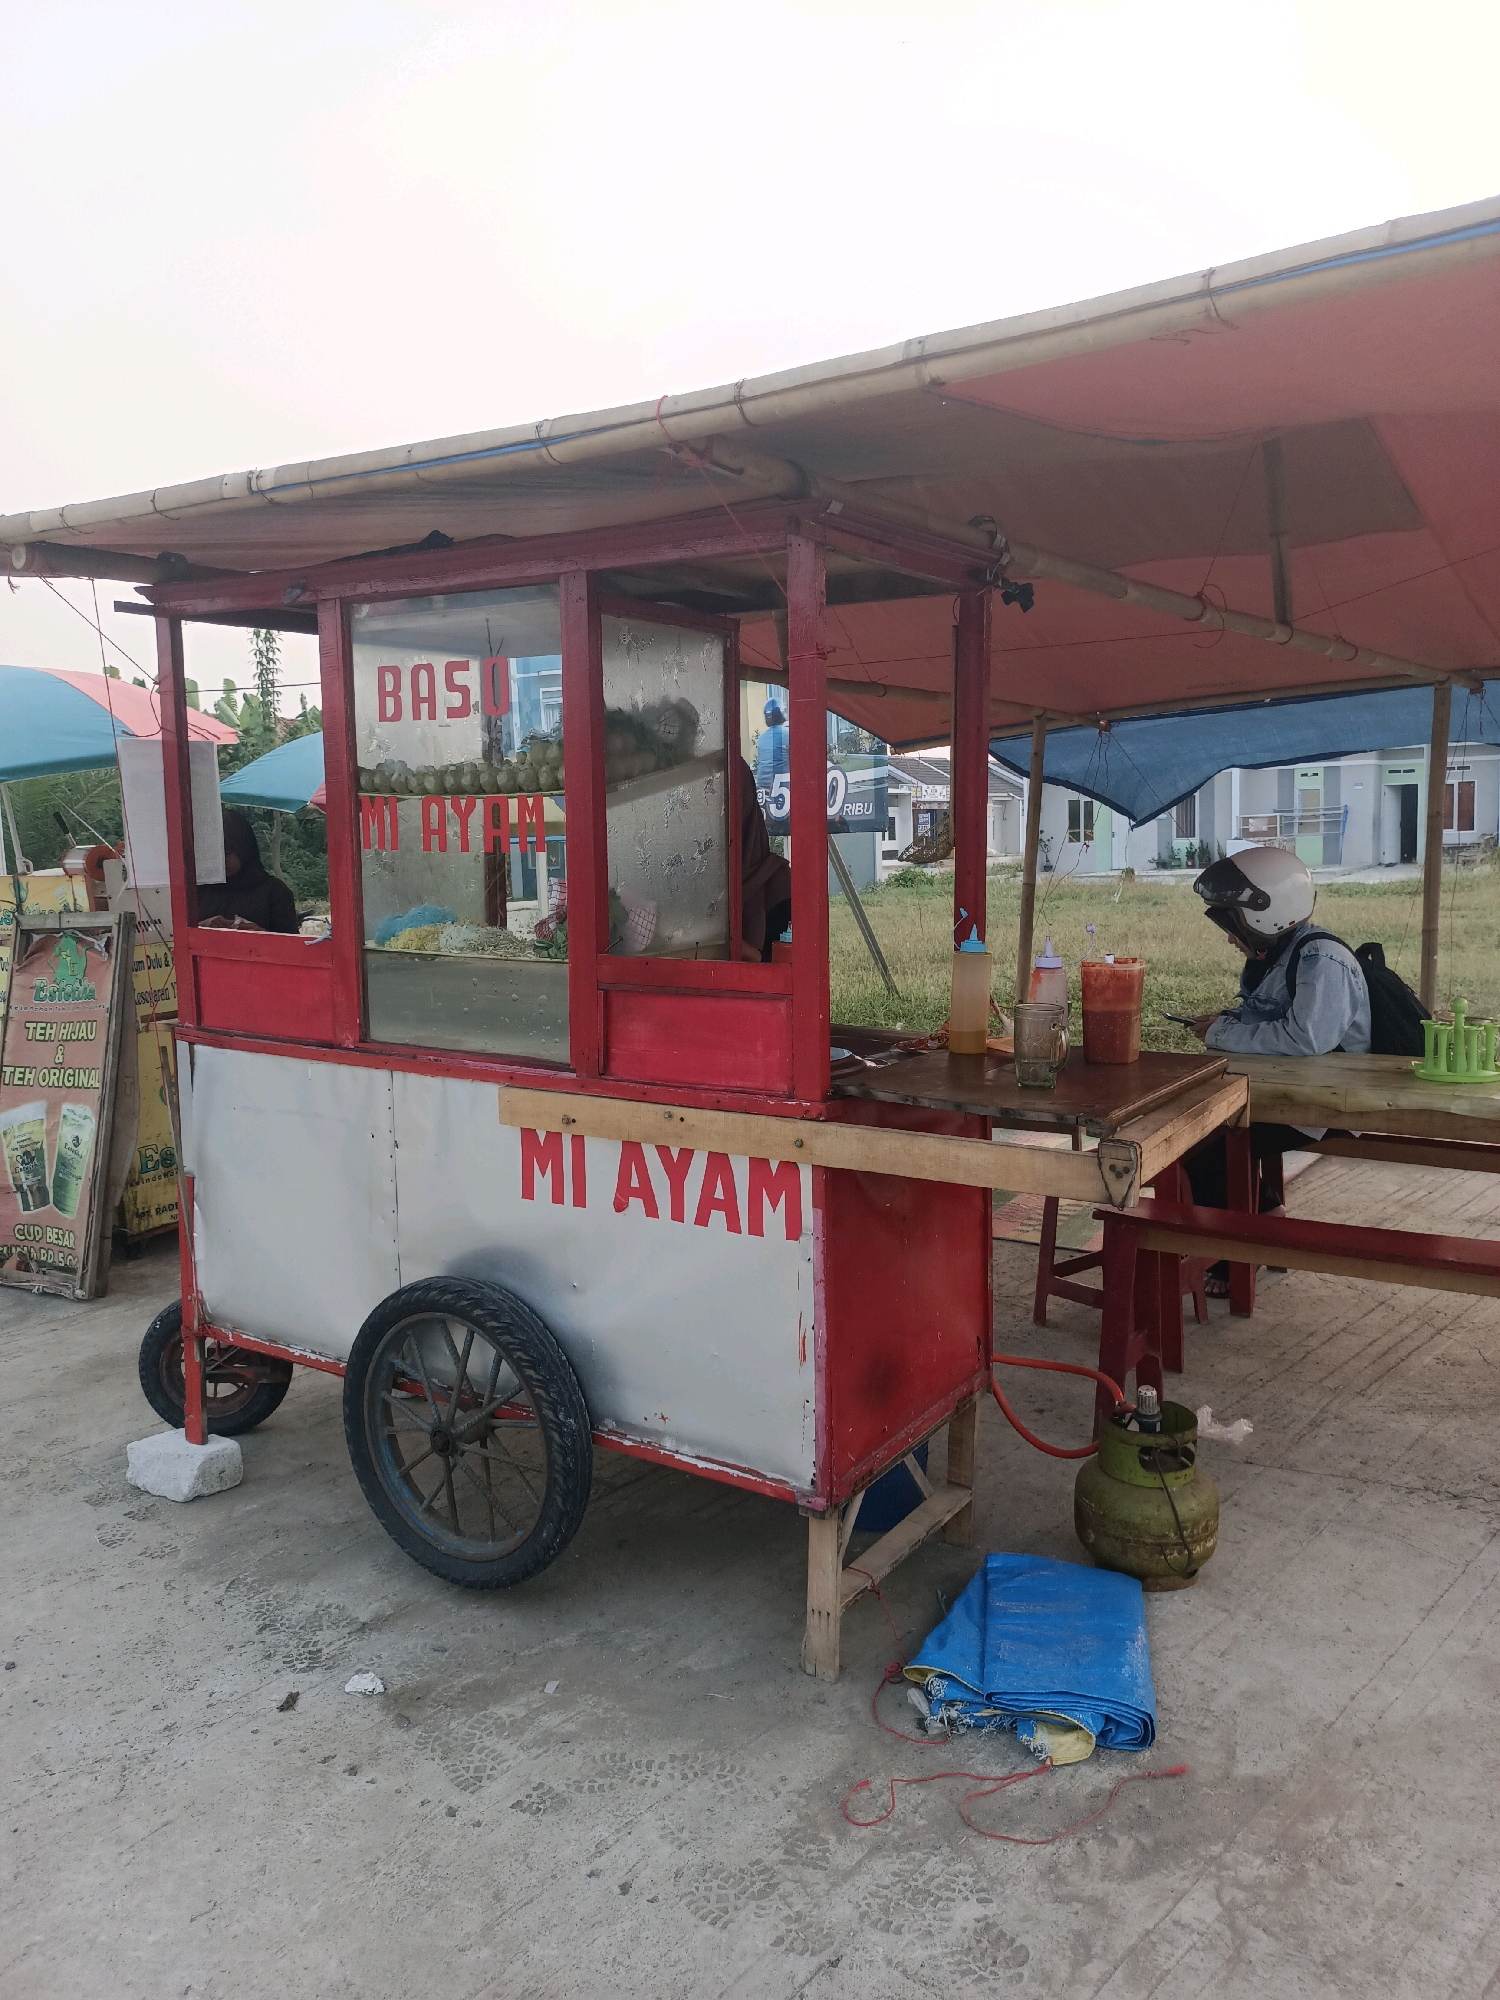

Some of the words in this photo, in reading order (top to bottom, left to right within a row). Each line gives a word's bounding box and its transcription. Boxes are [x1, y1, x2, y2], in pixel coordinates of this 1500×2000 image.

[377, 655, 511, 722] BASO
[769, 767, 846, 818] 50
[843, 802, 873, 816] RIBU
[360, 795, 399, 851] MI
[421, 793, 546, 853] AYAM
[25, 1021, 57, 1042] TEH
[58, 1020, 97, 1042] HIJAU
[54, 1044, 64, 1065] &
[2, 1065, 36, 1087] TEH
[38, 1067, 100, 1089] ORIGINAL
[520, 1127, 587, 1208] MI
[612, 1140, 802, 1242] AYAM
[155, 1201, 179, 1215] RADE
[14, 1223, 43, 1242] CUP
[46, 1225, 76, 1251] BESAR
